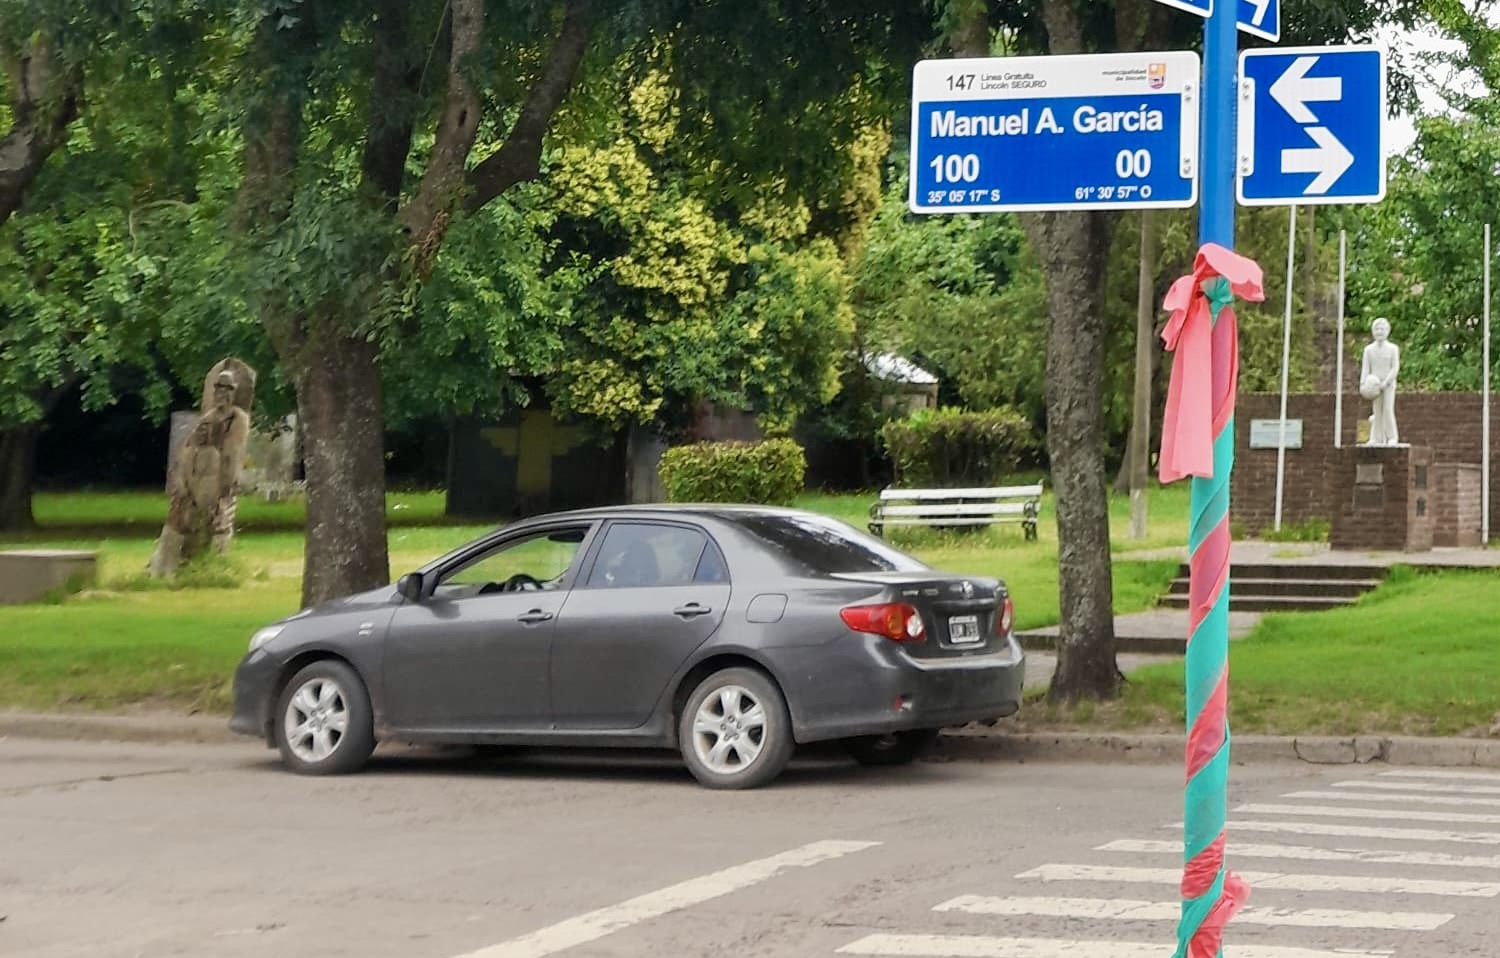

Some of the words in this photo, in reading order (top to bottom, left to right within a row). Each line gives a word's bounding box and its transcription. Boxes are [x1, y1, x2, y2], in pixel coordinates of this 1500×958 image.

[945, 74, 976, 91] 147
[930, 108, 1029, 138] Manuel
[1035, 107, 1065, 134] A.
[1072, 104, 1164, 134] García
[930, 154, 980, 184] 100
[1115, 149, 1151, 179] 00
[990, 188, 1001, 202] S
